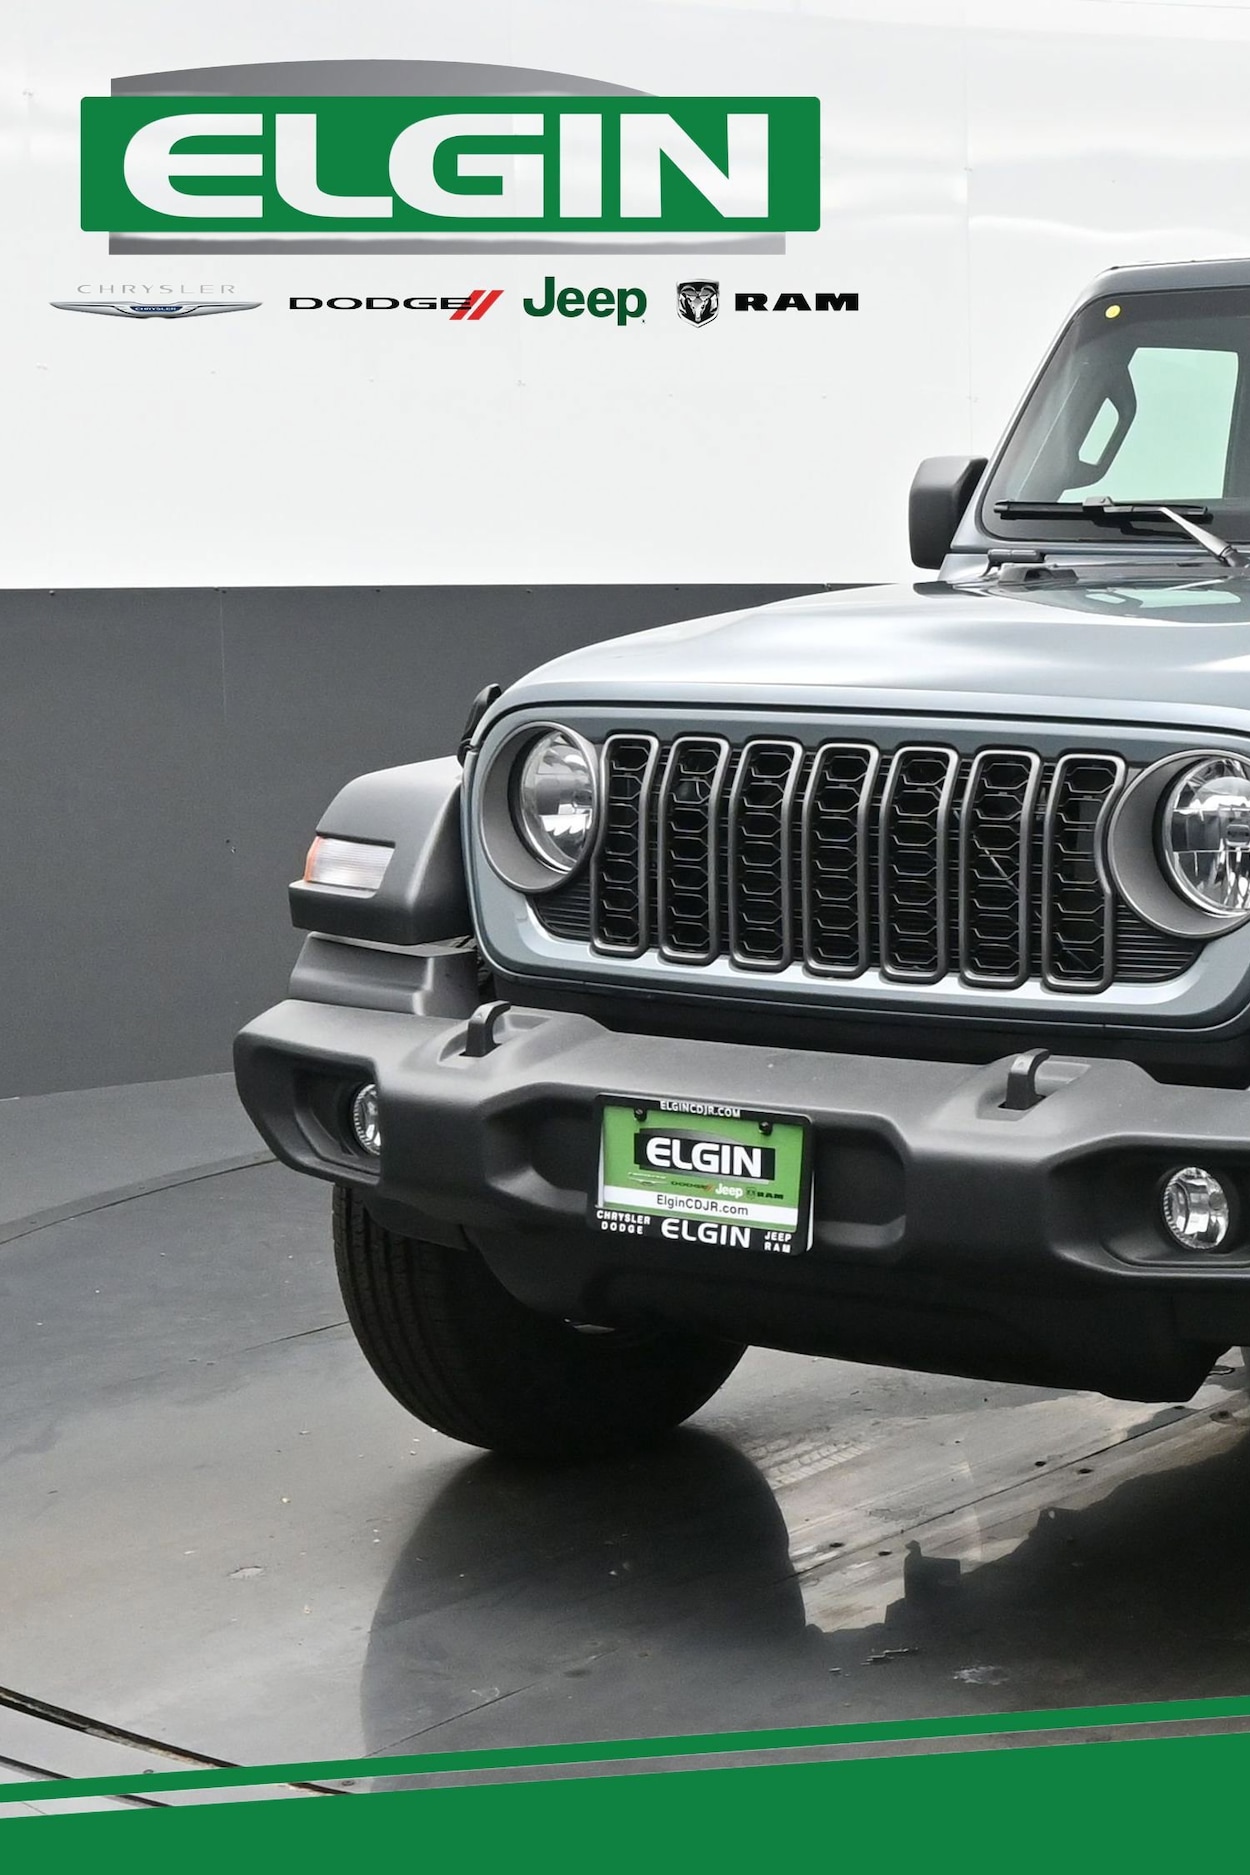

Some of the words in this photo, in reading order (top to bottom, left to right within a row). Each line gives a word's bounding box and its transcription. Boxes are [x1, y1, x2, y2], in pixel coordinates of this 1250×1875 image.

[659, 1100, 741, 1119] ELGINCDJR.COM
[645, 1136, 762, 1178] ELGIN
[715, 1183, 744, 1199] Jeep
[757, 1191, 784, 1200] RAM
[656, 1194, 749, 1216] ElginCDJR.com
[596, 1210, 651, 1225] CHRYSLER
[601, 1222, 644, 1235] DODGE
[661, 1218, 751, 1249] ELGIN
[764, 1231, 792, 1243] JEEP
[764, 1241, 791, 1254] RAM
